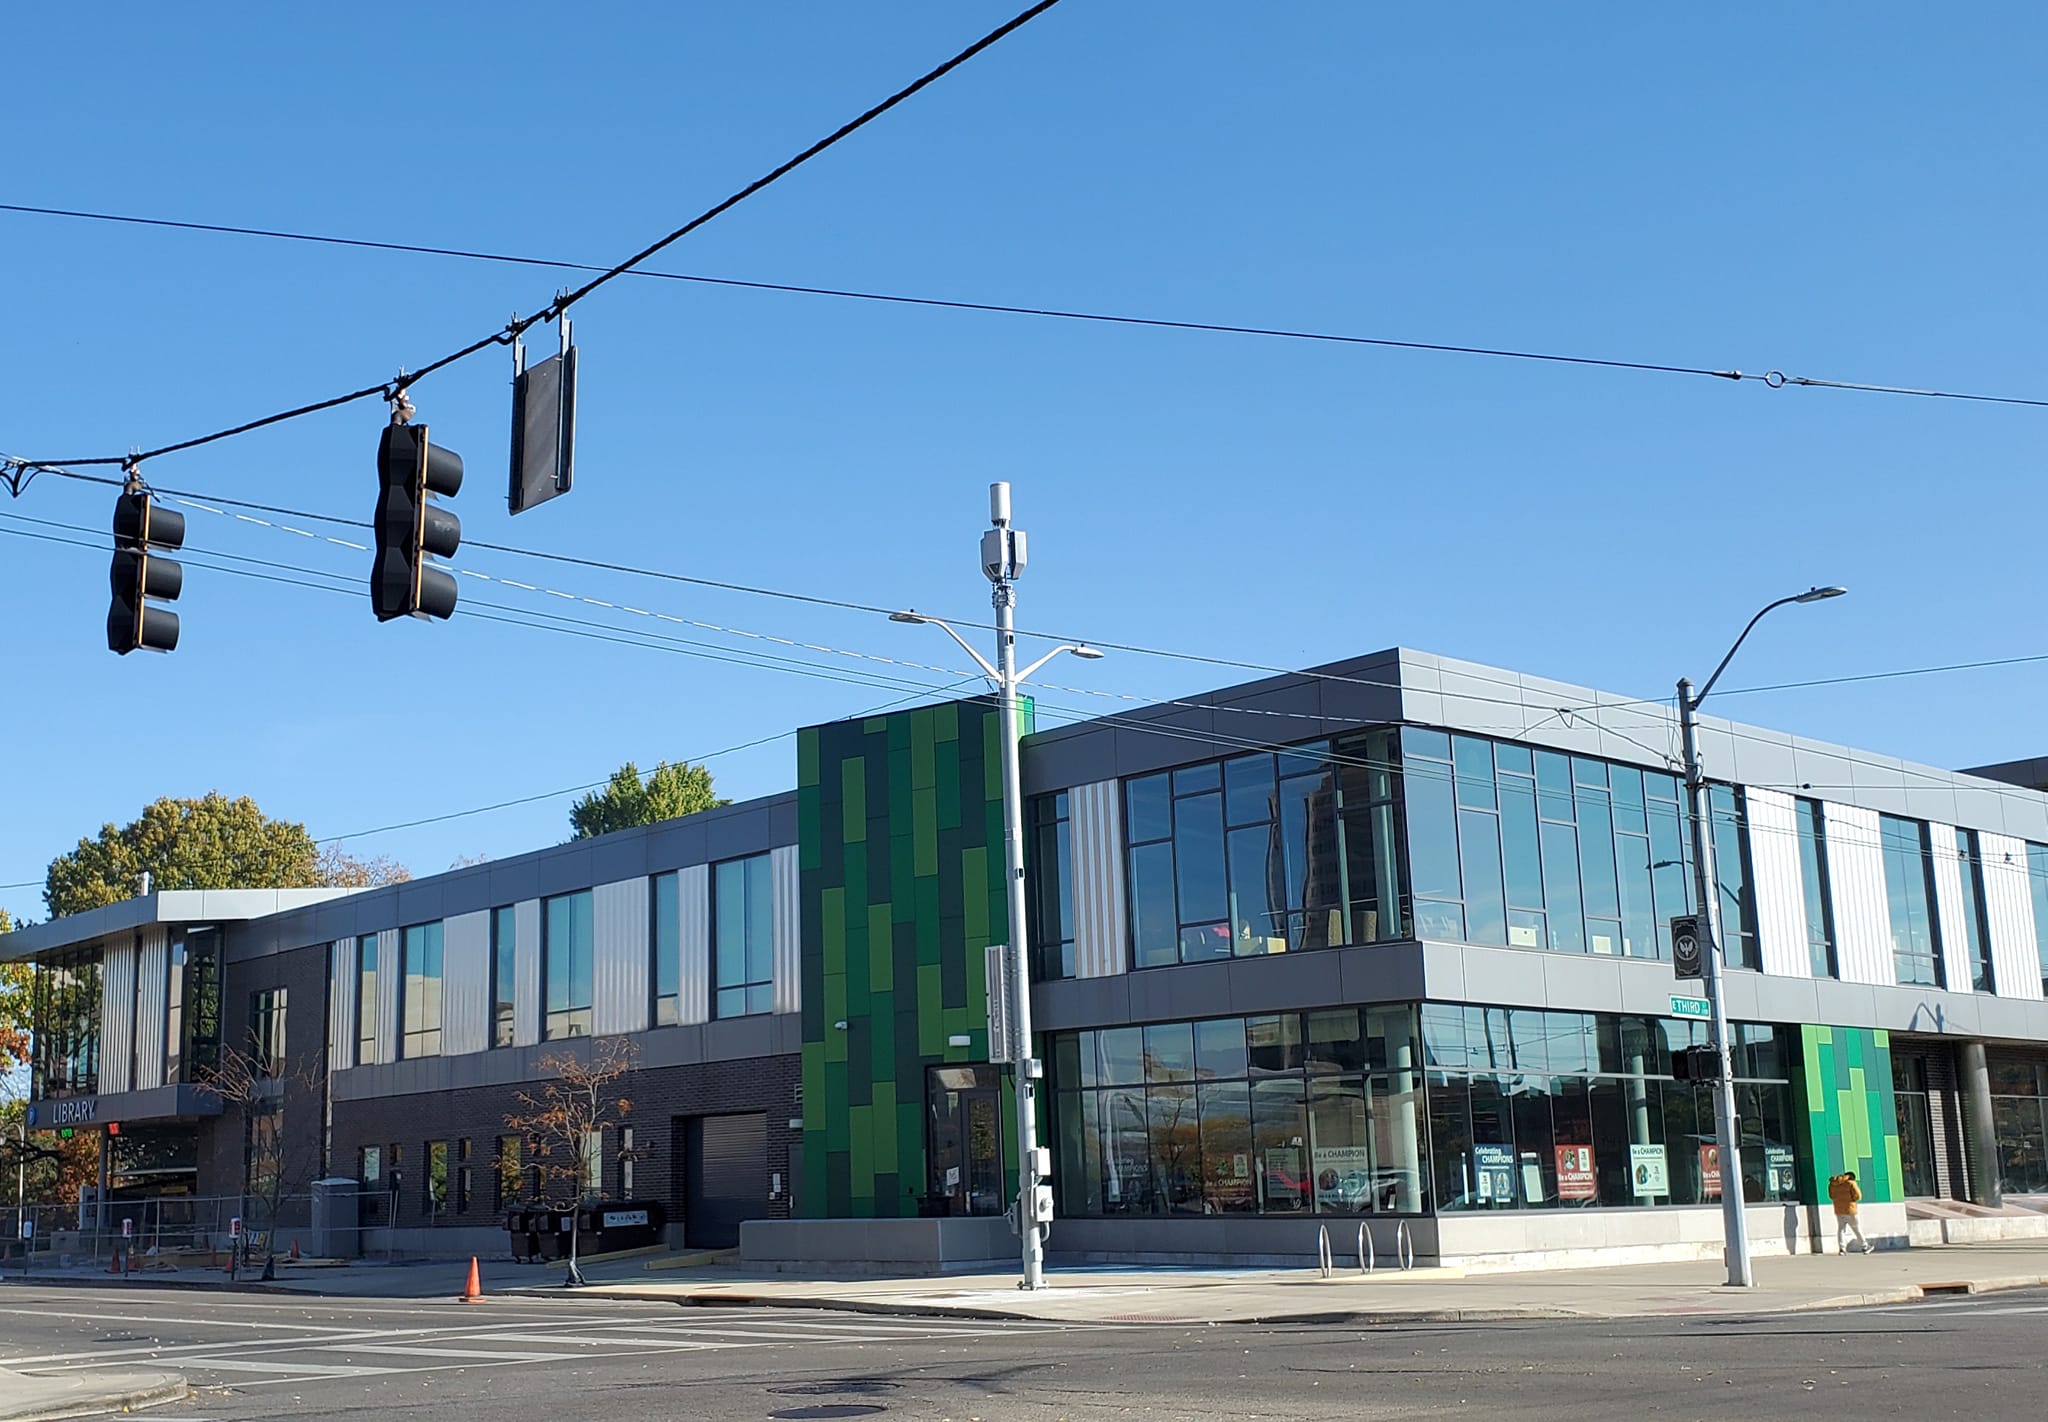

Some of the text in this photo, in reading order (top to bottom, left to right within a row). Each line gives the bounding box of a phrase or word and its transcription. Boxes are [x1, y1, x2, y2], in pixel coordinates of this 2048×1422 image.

[1672, 1000, 1678, 1010] E
[1677, 1000, 1700, 1014] THIRD
[53, 1100, 95, 1124] LIBRARY
[1327, 1149, 1365, 1158] CHAMPION
[1475, 1146, 1502, 1156] Celebrating
[1640, 1147, 1664, 1155] CHAMPION
[1765, 1147, 1786, 1157] Celebrating
[1482, 1155, 1514, 1164] CHAMPIONS
[1771, 1155, 1794, 1163] CHAMPIONS
[1568, 1172, 1593, 1181] CHAMPION
[1218, 1178, 1253, 1187] CHAMPION
